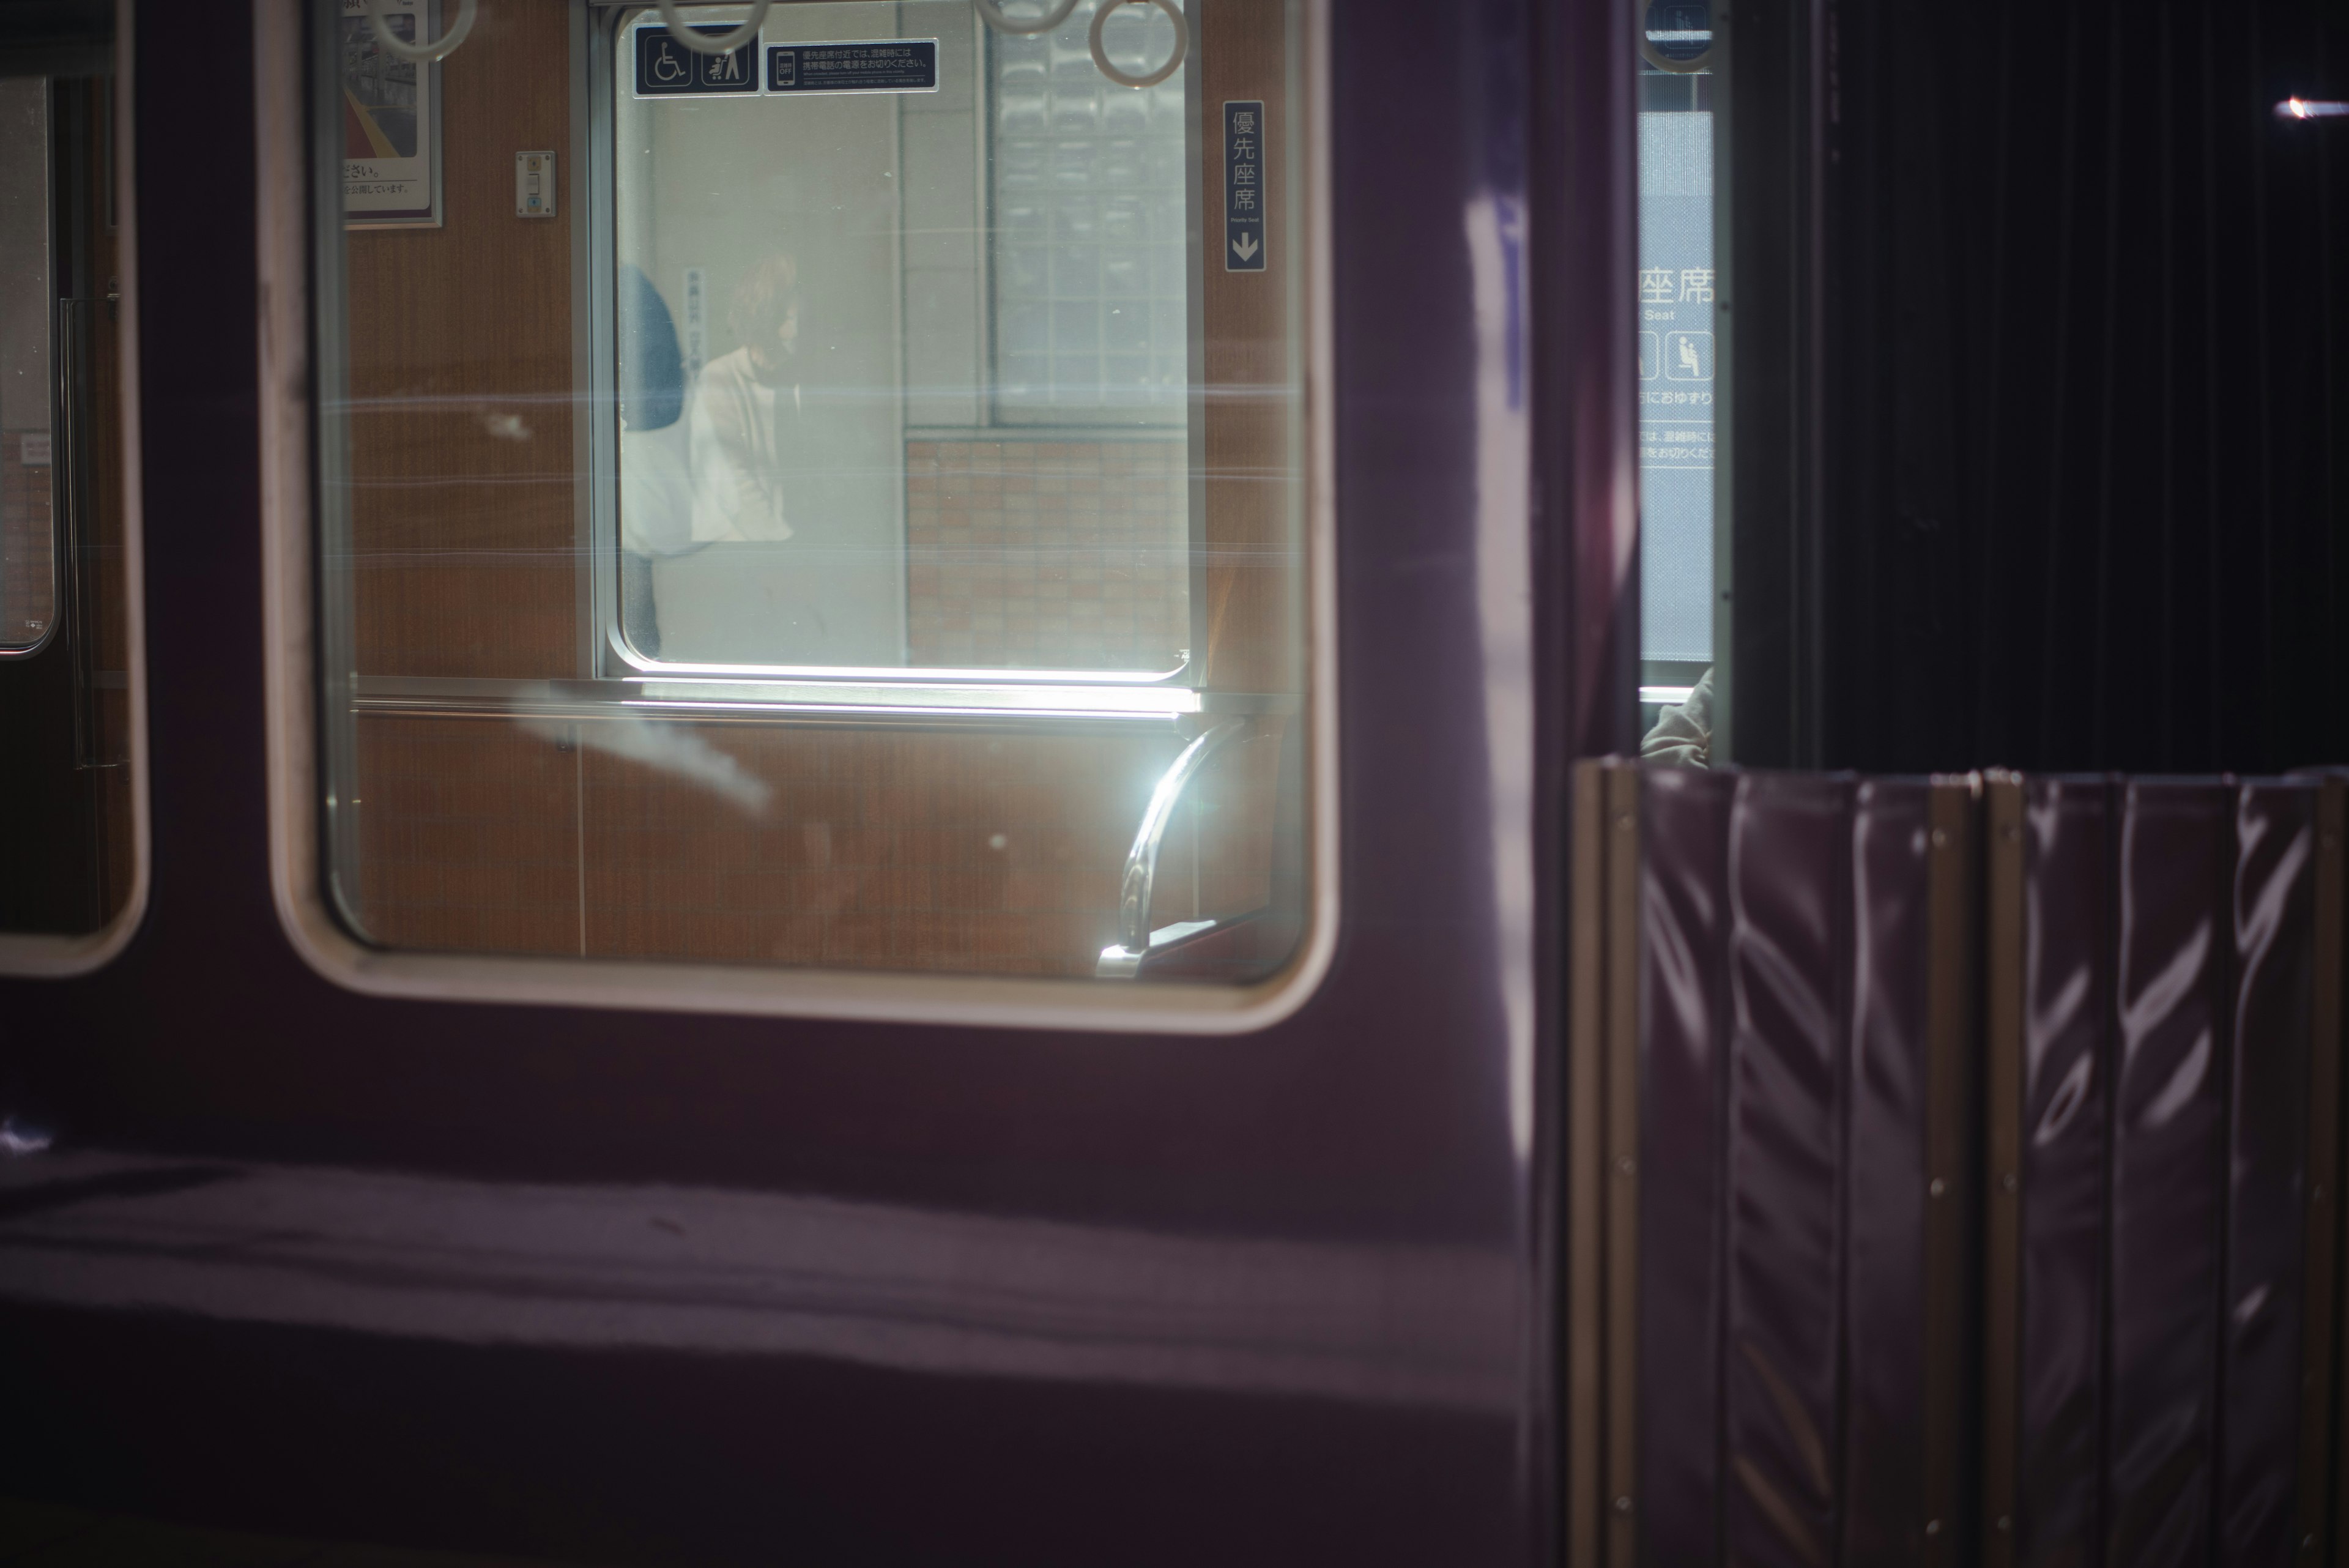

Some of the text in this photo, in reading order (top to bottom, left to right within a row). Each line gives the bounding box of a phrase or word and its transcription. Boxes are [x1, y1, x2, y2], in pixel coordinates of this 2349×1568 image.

[803, 49, 911, 59] 優先座席付近では、混雑時には
[803, 59, 926, 70] 携帯電話の電源をお切りください。
[1233, 111, 1255, 210] 優先座席
[344, 184, 409, 195] を公開しています。
[1639, 266, 1715, 305] 座席
[1644, 309, 1674, 321] Seat
